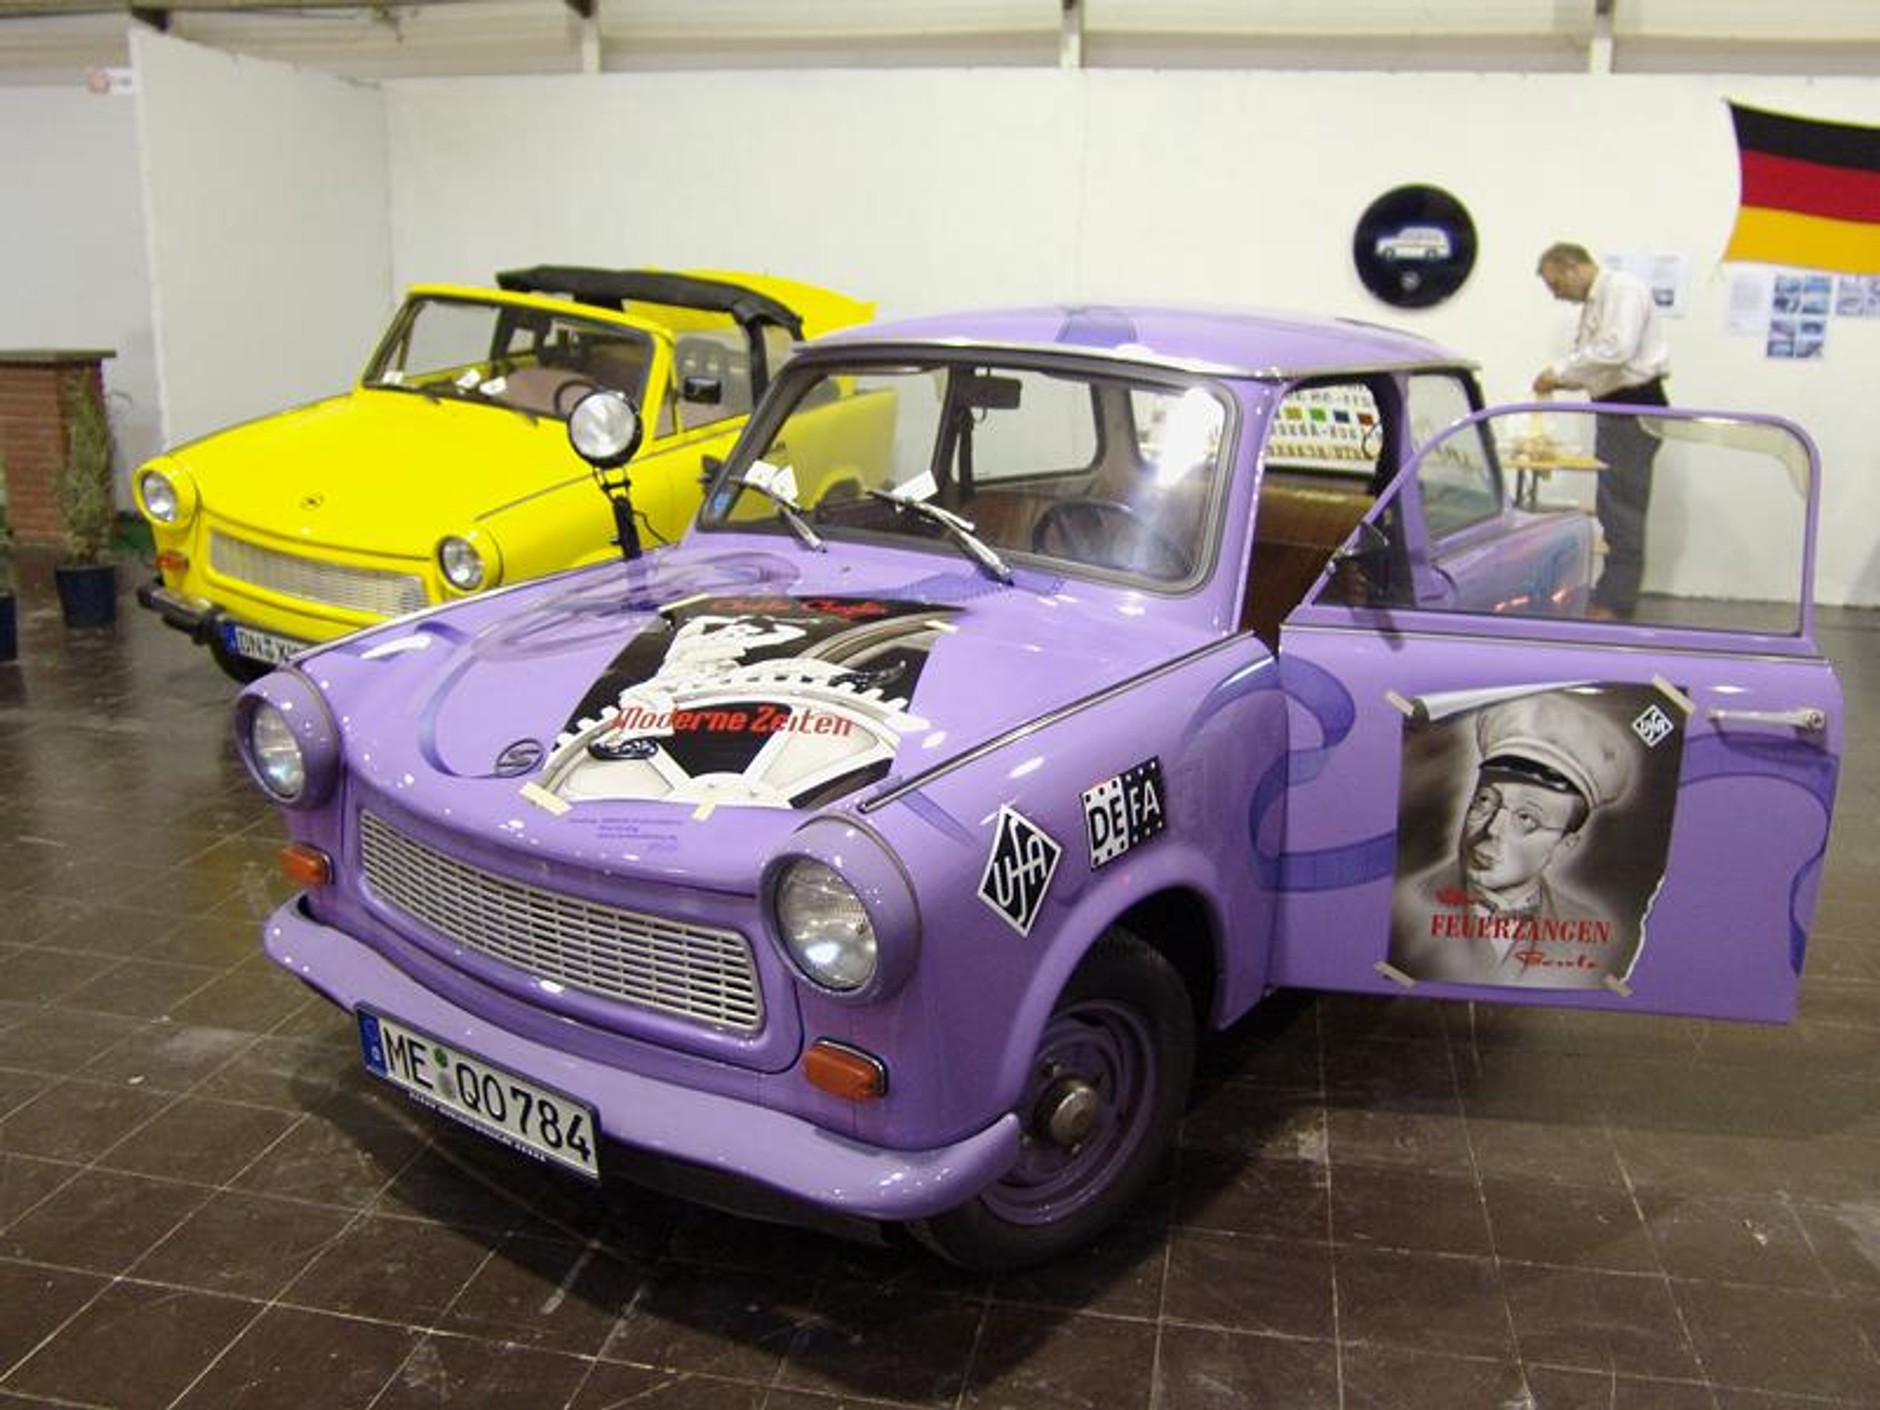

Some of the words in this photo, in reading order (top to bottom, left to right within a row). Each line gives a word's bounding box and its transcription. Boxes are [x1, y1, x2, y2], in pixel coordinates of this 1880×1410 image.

[610, 705, 747, 731] Moderne
[749, 704, 852, 737] Zeiten
[1088, 779, 1161, 851] DEFA
[1430, 914, 1612, 943] FEUERZANGEN
[383, 1027, 433, 1090] ME
